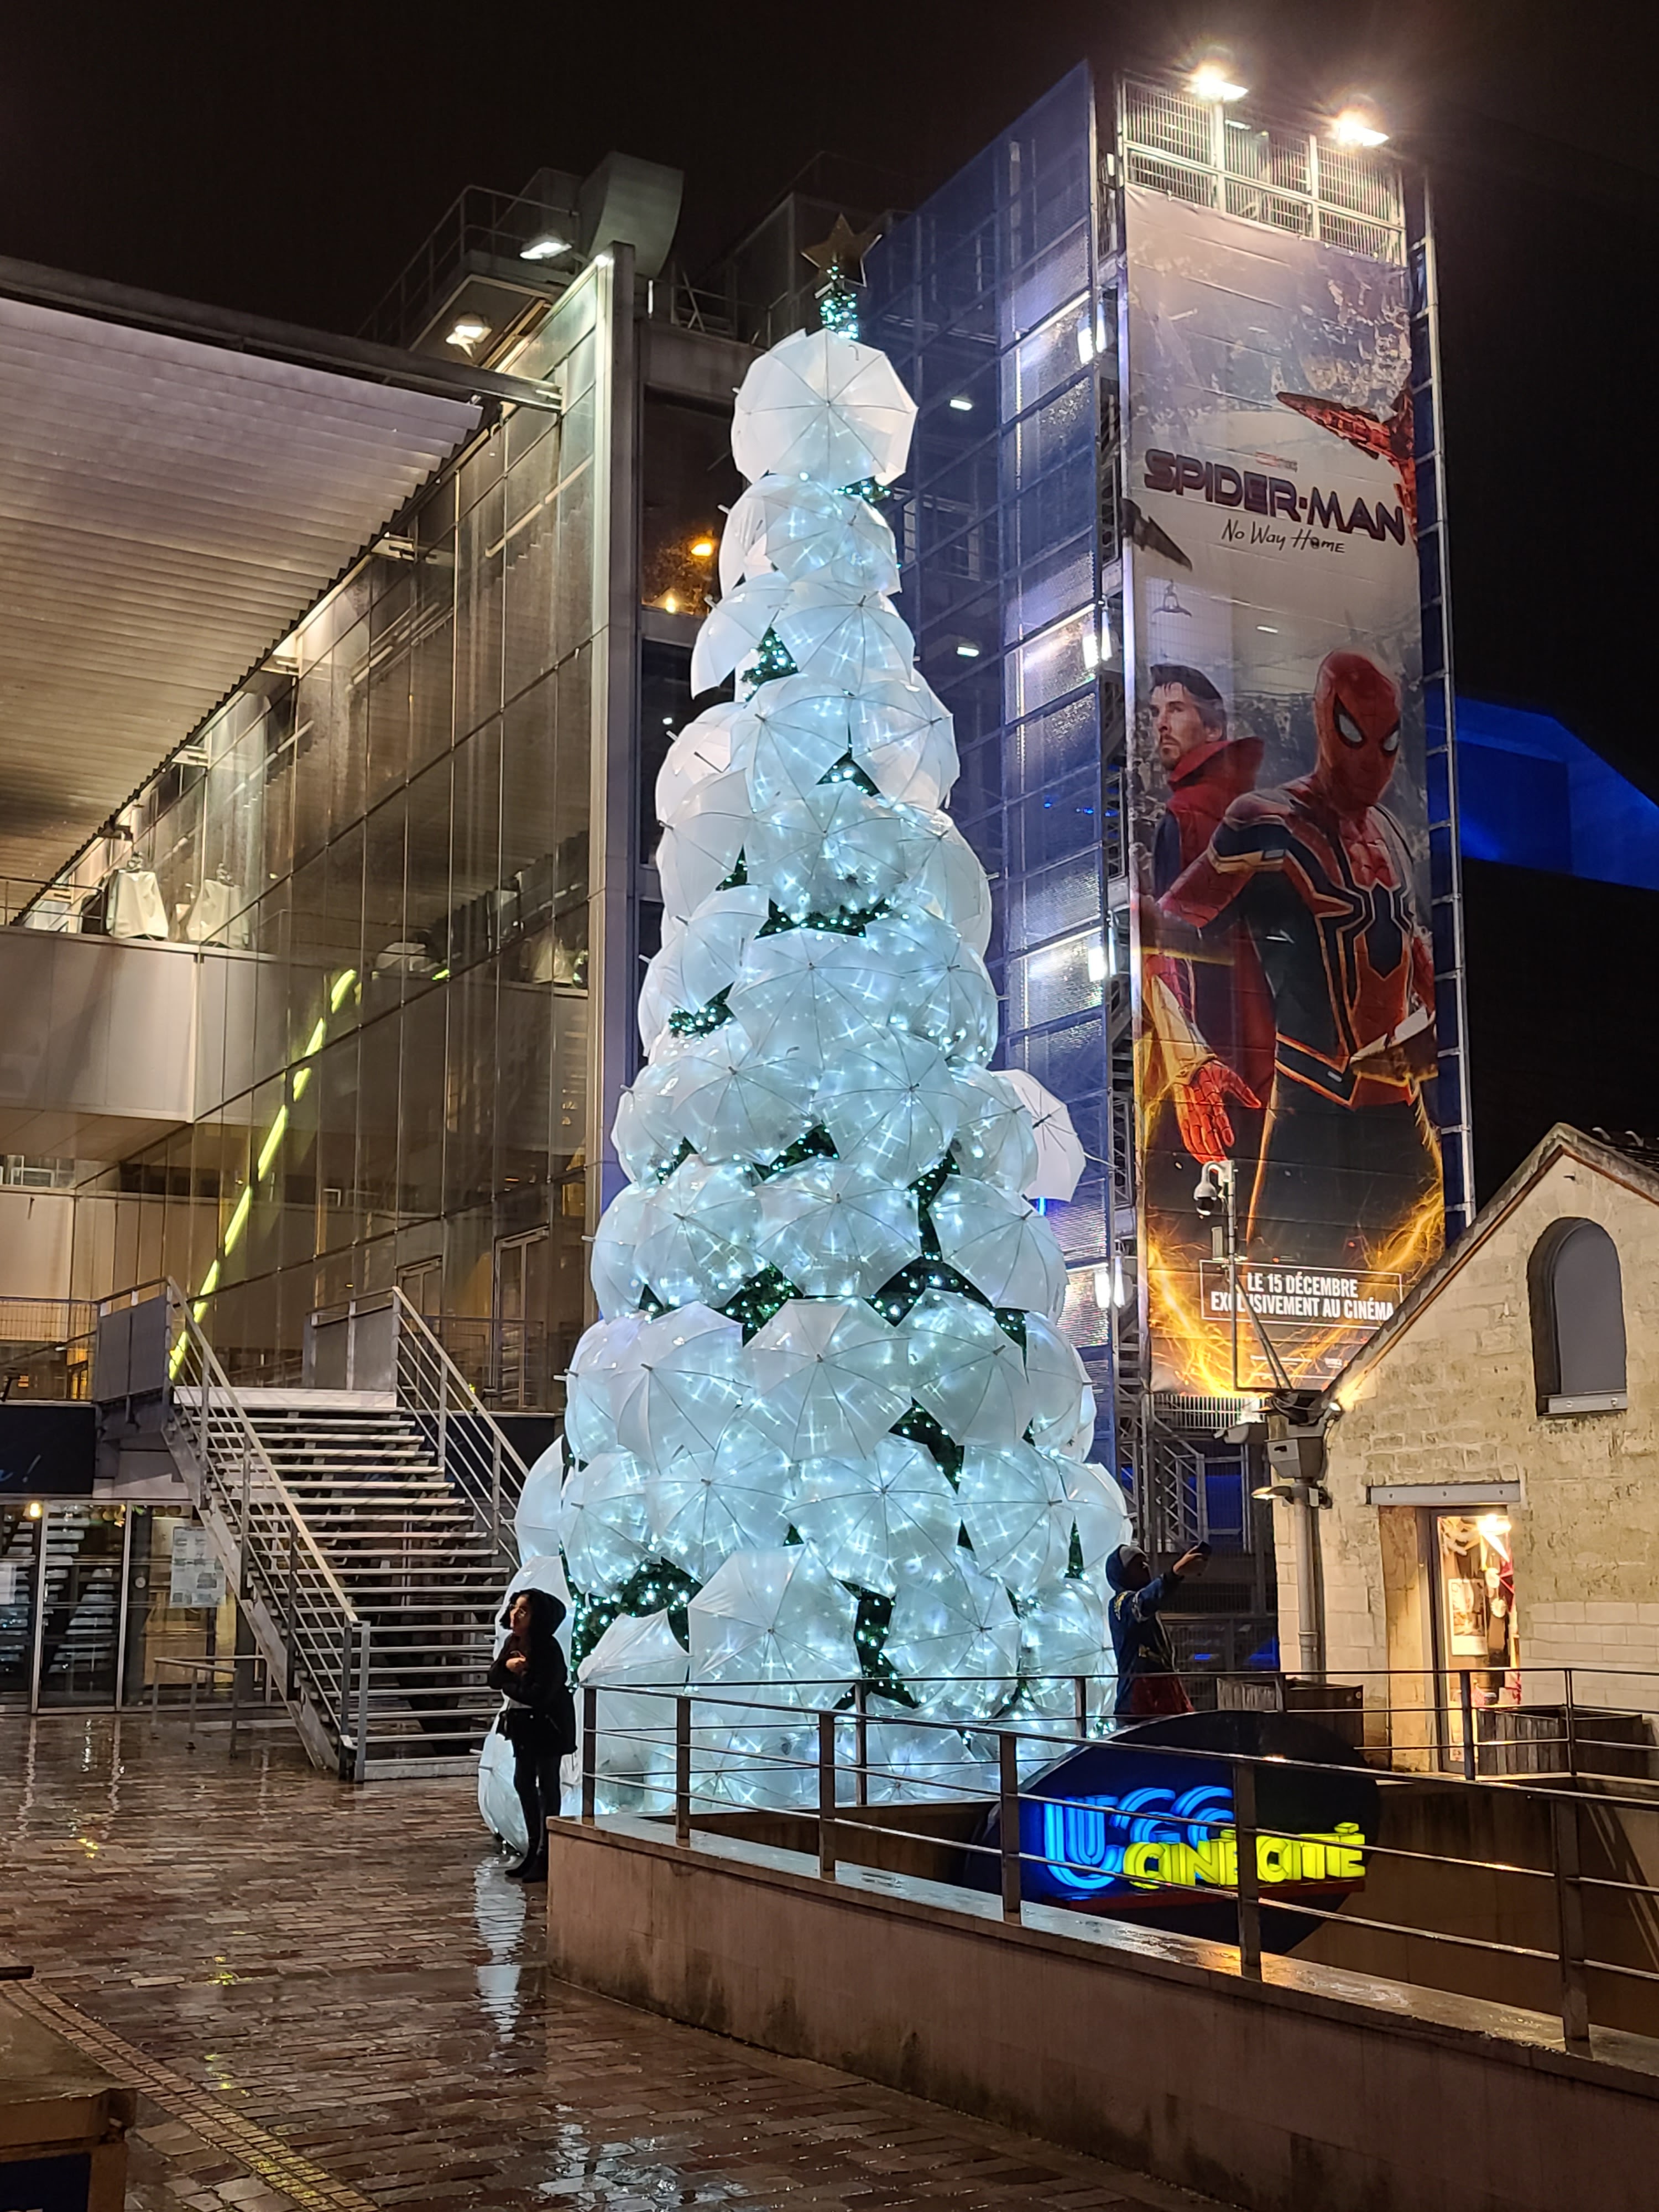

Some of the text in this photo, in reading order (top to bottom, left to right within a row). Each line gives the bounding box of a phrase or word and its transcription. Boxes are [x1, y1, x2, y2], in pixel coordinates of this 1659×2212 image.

[1221, 519, 1245, 541] No
[1250, 525, 1285, 550] Way
[1248, 1271, 1358, 1297] LE 15 DÉCEMBRE
[1322, 1298, 1340, 1318] AU
[1344, 1297, 1394, 1321] CINÉMA
